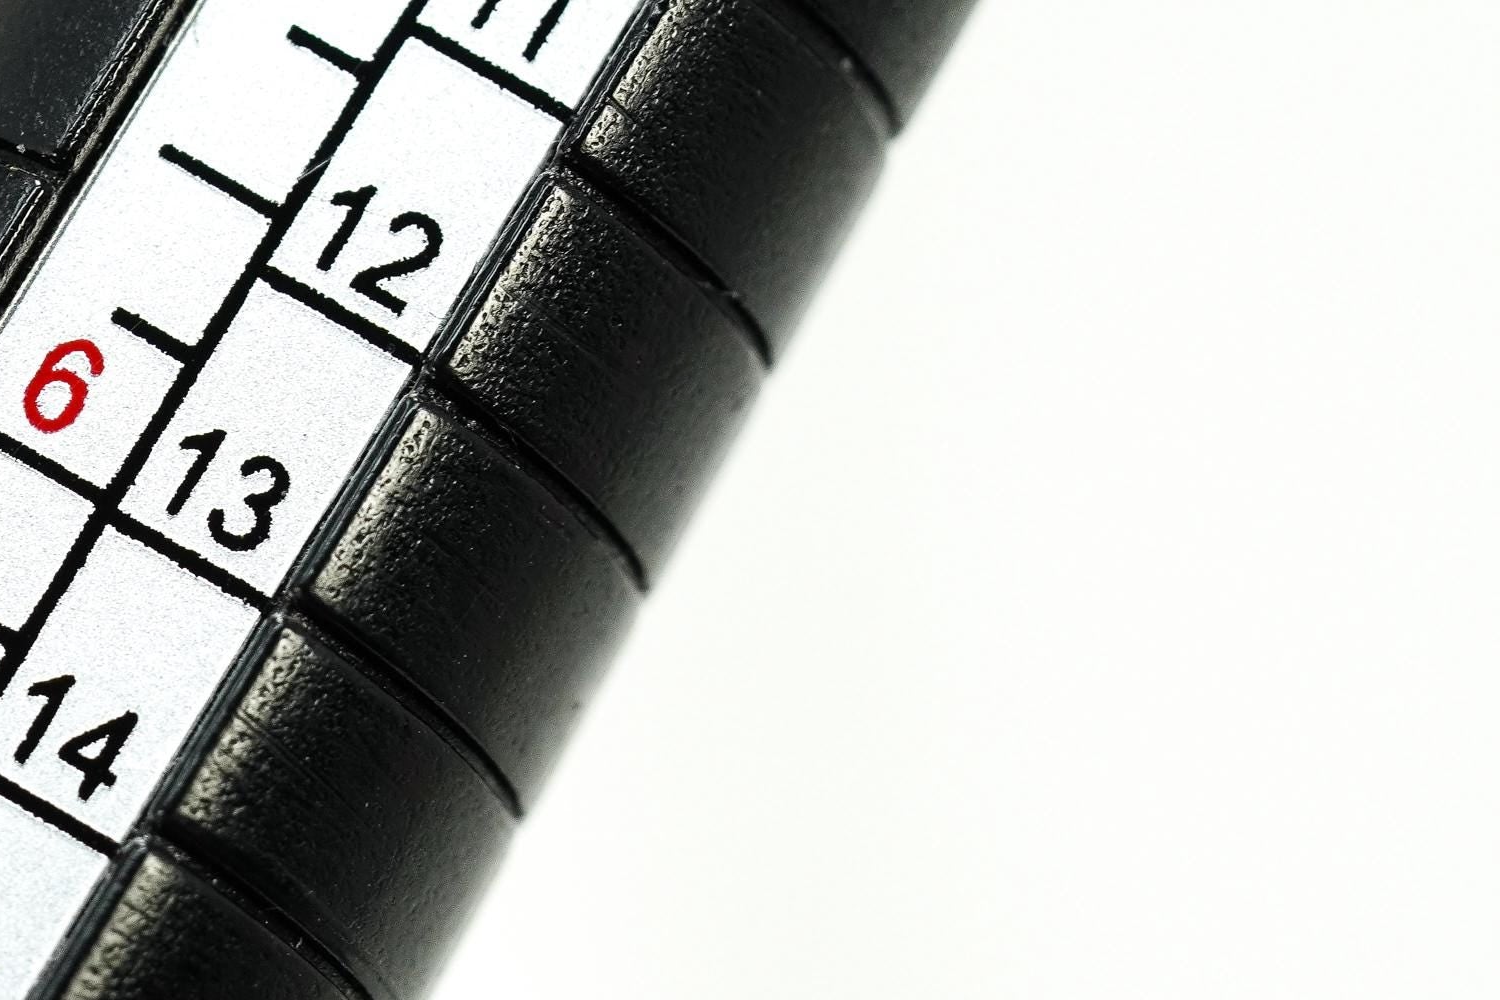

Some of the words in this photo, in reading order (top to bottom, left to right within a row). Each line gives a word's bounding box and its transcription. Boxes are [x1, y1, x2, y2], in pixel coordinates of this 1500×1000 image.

[315, 184, 444, 318] 12
[22, 338, 105, 435] 6
[165, 428, 291, 552] 13
[13, 674, 139, 802] 14
